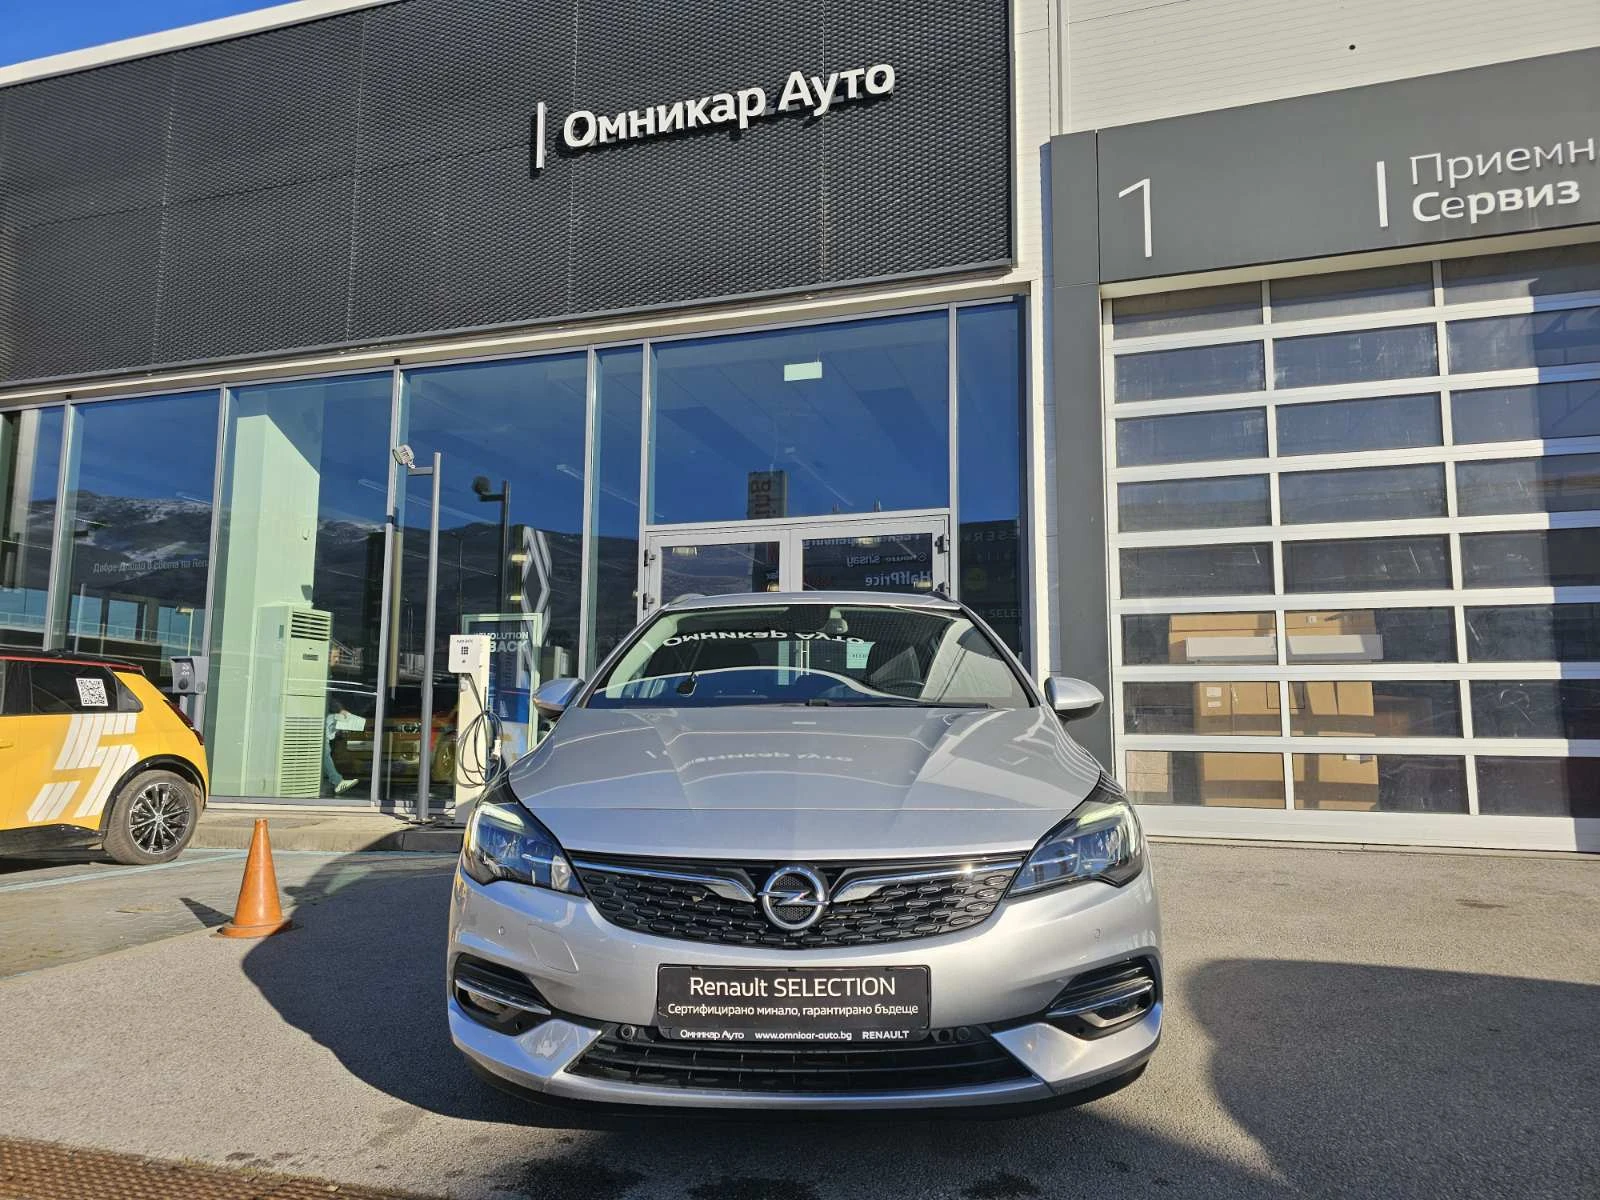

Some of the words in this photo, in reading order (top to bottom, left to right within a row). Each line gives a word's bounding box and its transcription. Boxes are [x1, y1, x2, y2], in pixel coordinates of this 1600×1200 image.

[563, 86, 767, 148] Омникар
[778, 63, 896, 116] Ауто
[1118, 178, 1152, 258] 1
[1412, 180, 1581, 224] Сервиз
[690, 977, 768, 996] Renault
[774, 977, 896, 997] SELECTION
[668, 1003, 755, 1016] Сертифицирано
[757, 1005, 801, 1017] минало,
[802, 1005, 872, 1017] гарантирано
[874, 1003, 919, 1015] бъдеще
[680, 1029, 720, 1041] Омникар
[721, 1030, 745, 1041] Ауто
[862, 1030, 910, 1040] RENAULT
